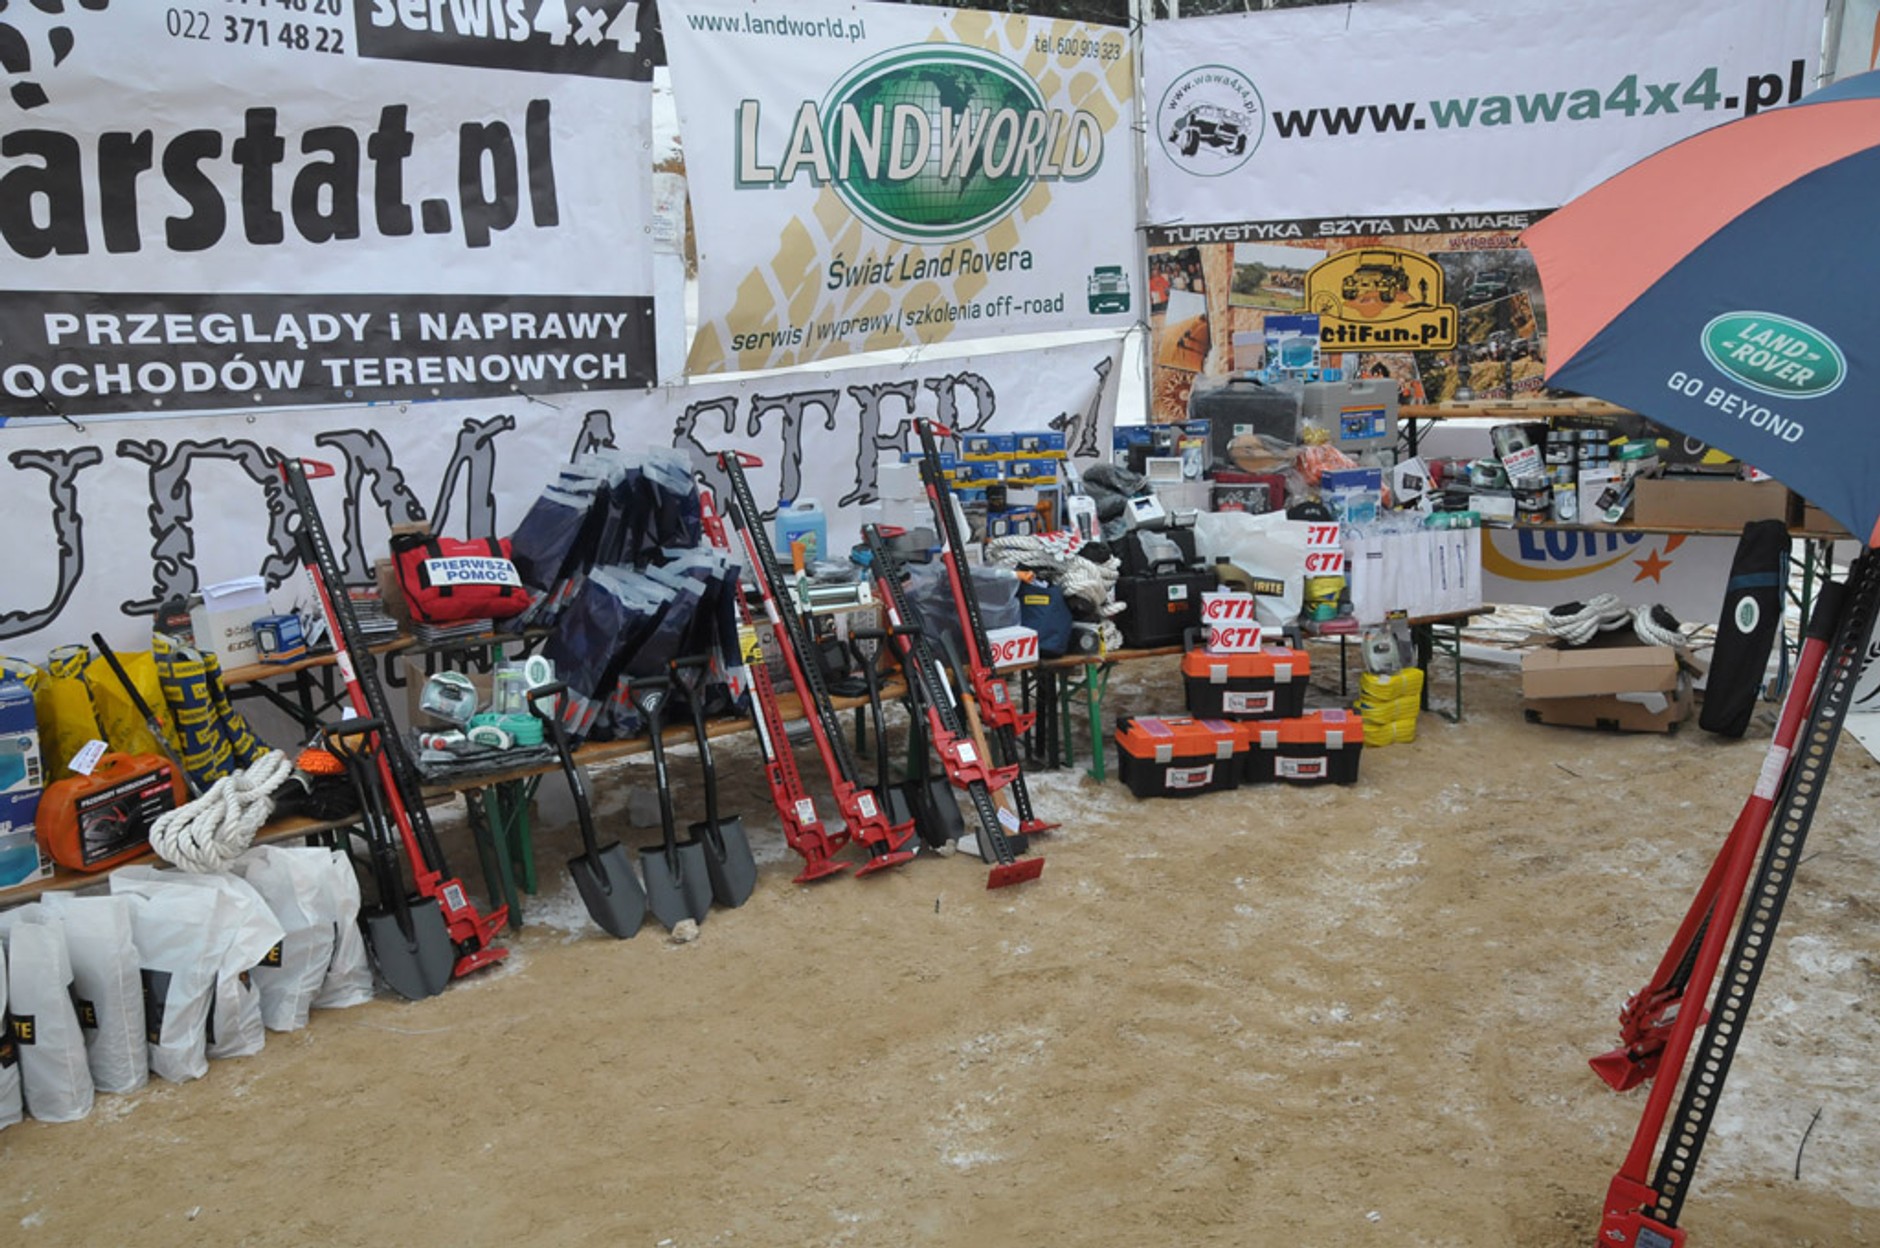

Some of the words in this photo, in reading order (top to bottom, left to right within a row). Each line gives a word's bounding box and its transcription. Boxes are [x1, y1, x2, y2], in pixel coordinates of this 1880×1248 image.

[166, 8, 211, 41] 022
[224, 15, 269, 47] 371
[278, 22, 310, 51] 48
[315, 26, 345, 55] 22
[687, 12, 866, 42] www.landworld.pl
[1034, 33, 1054, 53] tel.
[1057, 36, 1078, 56] 600
[1080, 40, 1099, 58] 909
[1101, 43, 1121, 61] 323
[1168, 74, 1257, 114] www.wawa4x4.pl
[1272, 59, 1806, 138] www.wawa4x4.pl
[1164, 224, 1302, 243] TURYSTYKA
[1403, 216, 1440, 232] NA
[826, 255, 893, 290] Świat
[900, 250, 955, 281] Land
[959, 248, 1033, 274] Rovera
[44, 312, 374, 349] PRZEGLĄDY
[390, 312, 400, 341] i
[420, 312, 628, 341] NAPRAWY
[731, 325, 802, 352] serwis
[817, 311, 893, 343] wyprawy
[906, 299, 980, 326] szkolenia
[986, 294, 1064, 318] off-road
[1320, 316, 1449, 345] ctiFun.pl
[1737, 322, 1809, 358] LAND
[2, 353, 304, 398] OCHODÓW
[322, 353, 628, 388] TERENOWYCH
[1730, 343, 1816, 387] ROVER
[1667, 369, 1704, 397] GO
[1704, 386, 1805, 443] BEYOND
[446, 570, 509, 581] POMOC
